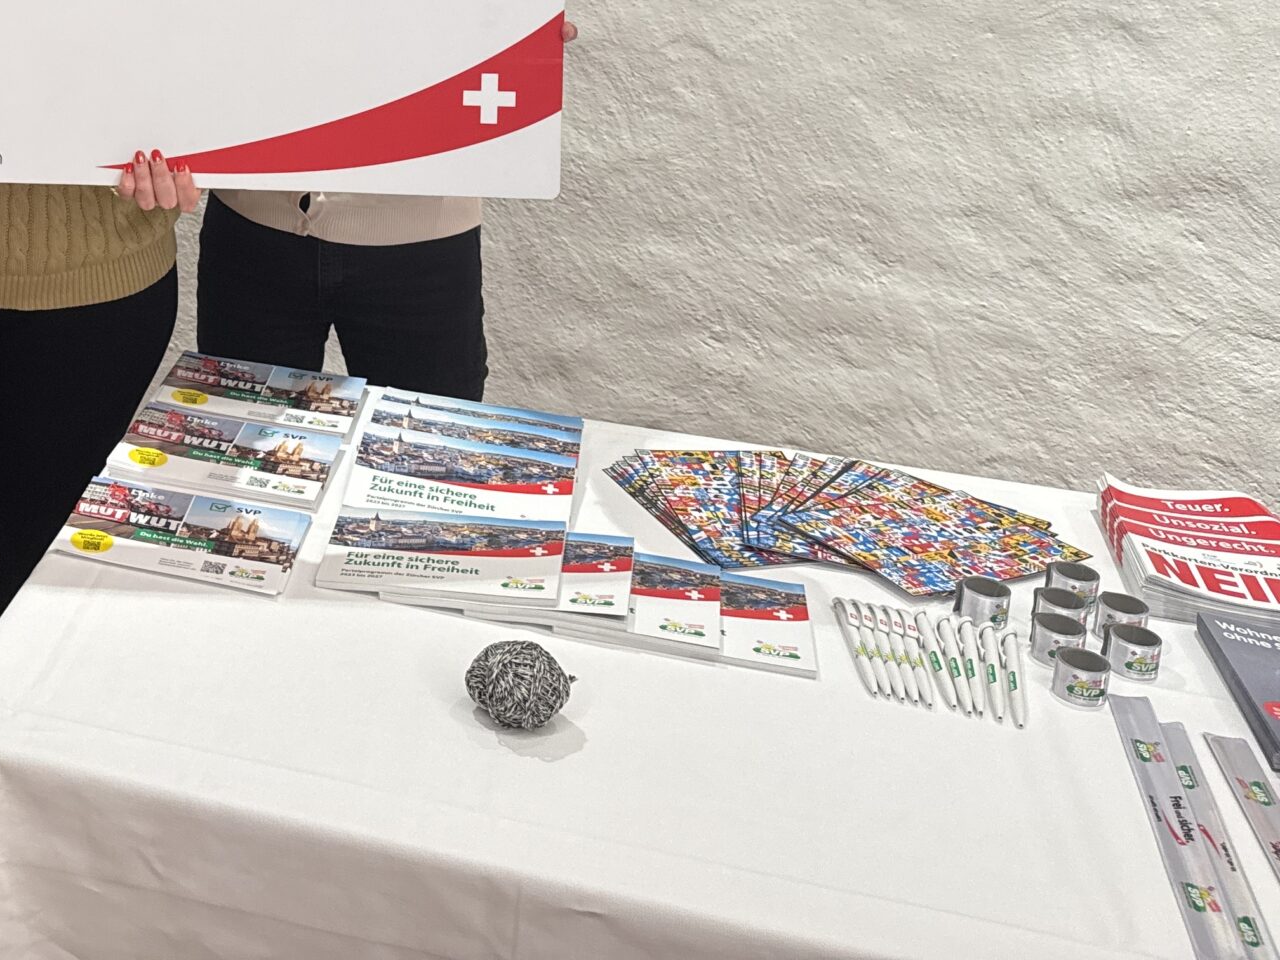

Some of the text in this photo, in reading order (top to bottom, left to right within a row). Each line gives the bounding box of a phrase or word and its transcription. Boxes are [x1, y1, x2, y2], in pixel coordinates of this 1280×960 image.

[372, 475, 477, 500] Für eine sichere
[369, 483, 496, 511] Zukunft in Freiheit
[236, 507, 262, 515] SVP
[1160, 500, 1231, 513] Teuer.
[1152, 514, 1257, 535] Unsozial.
[1148, 527, 1276, 554] Ungerecht.
[344, 558, 480, 575] Zukunft in Freiheit
[346, 551, 460, 566] Für eine sichere
[1140, 542, 1280, 577] Parkkarten-Verordn
[1223, 632, 1272, 649] ohne
[1132, 662, 1156, 672] SVP
[1073, 686, 1100, 697] SVP
[1187, 886, 1204, 907] SVP
